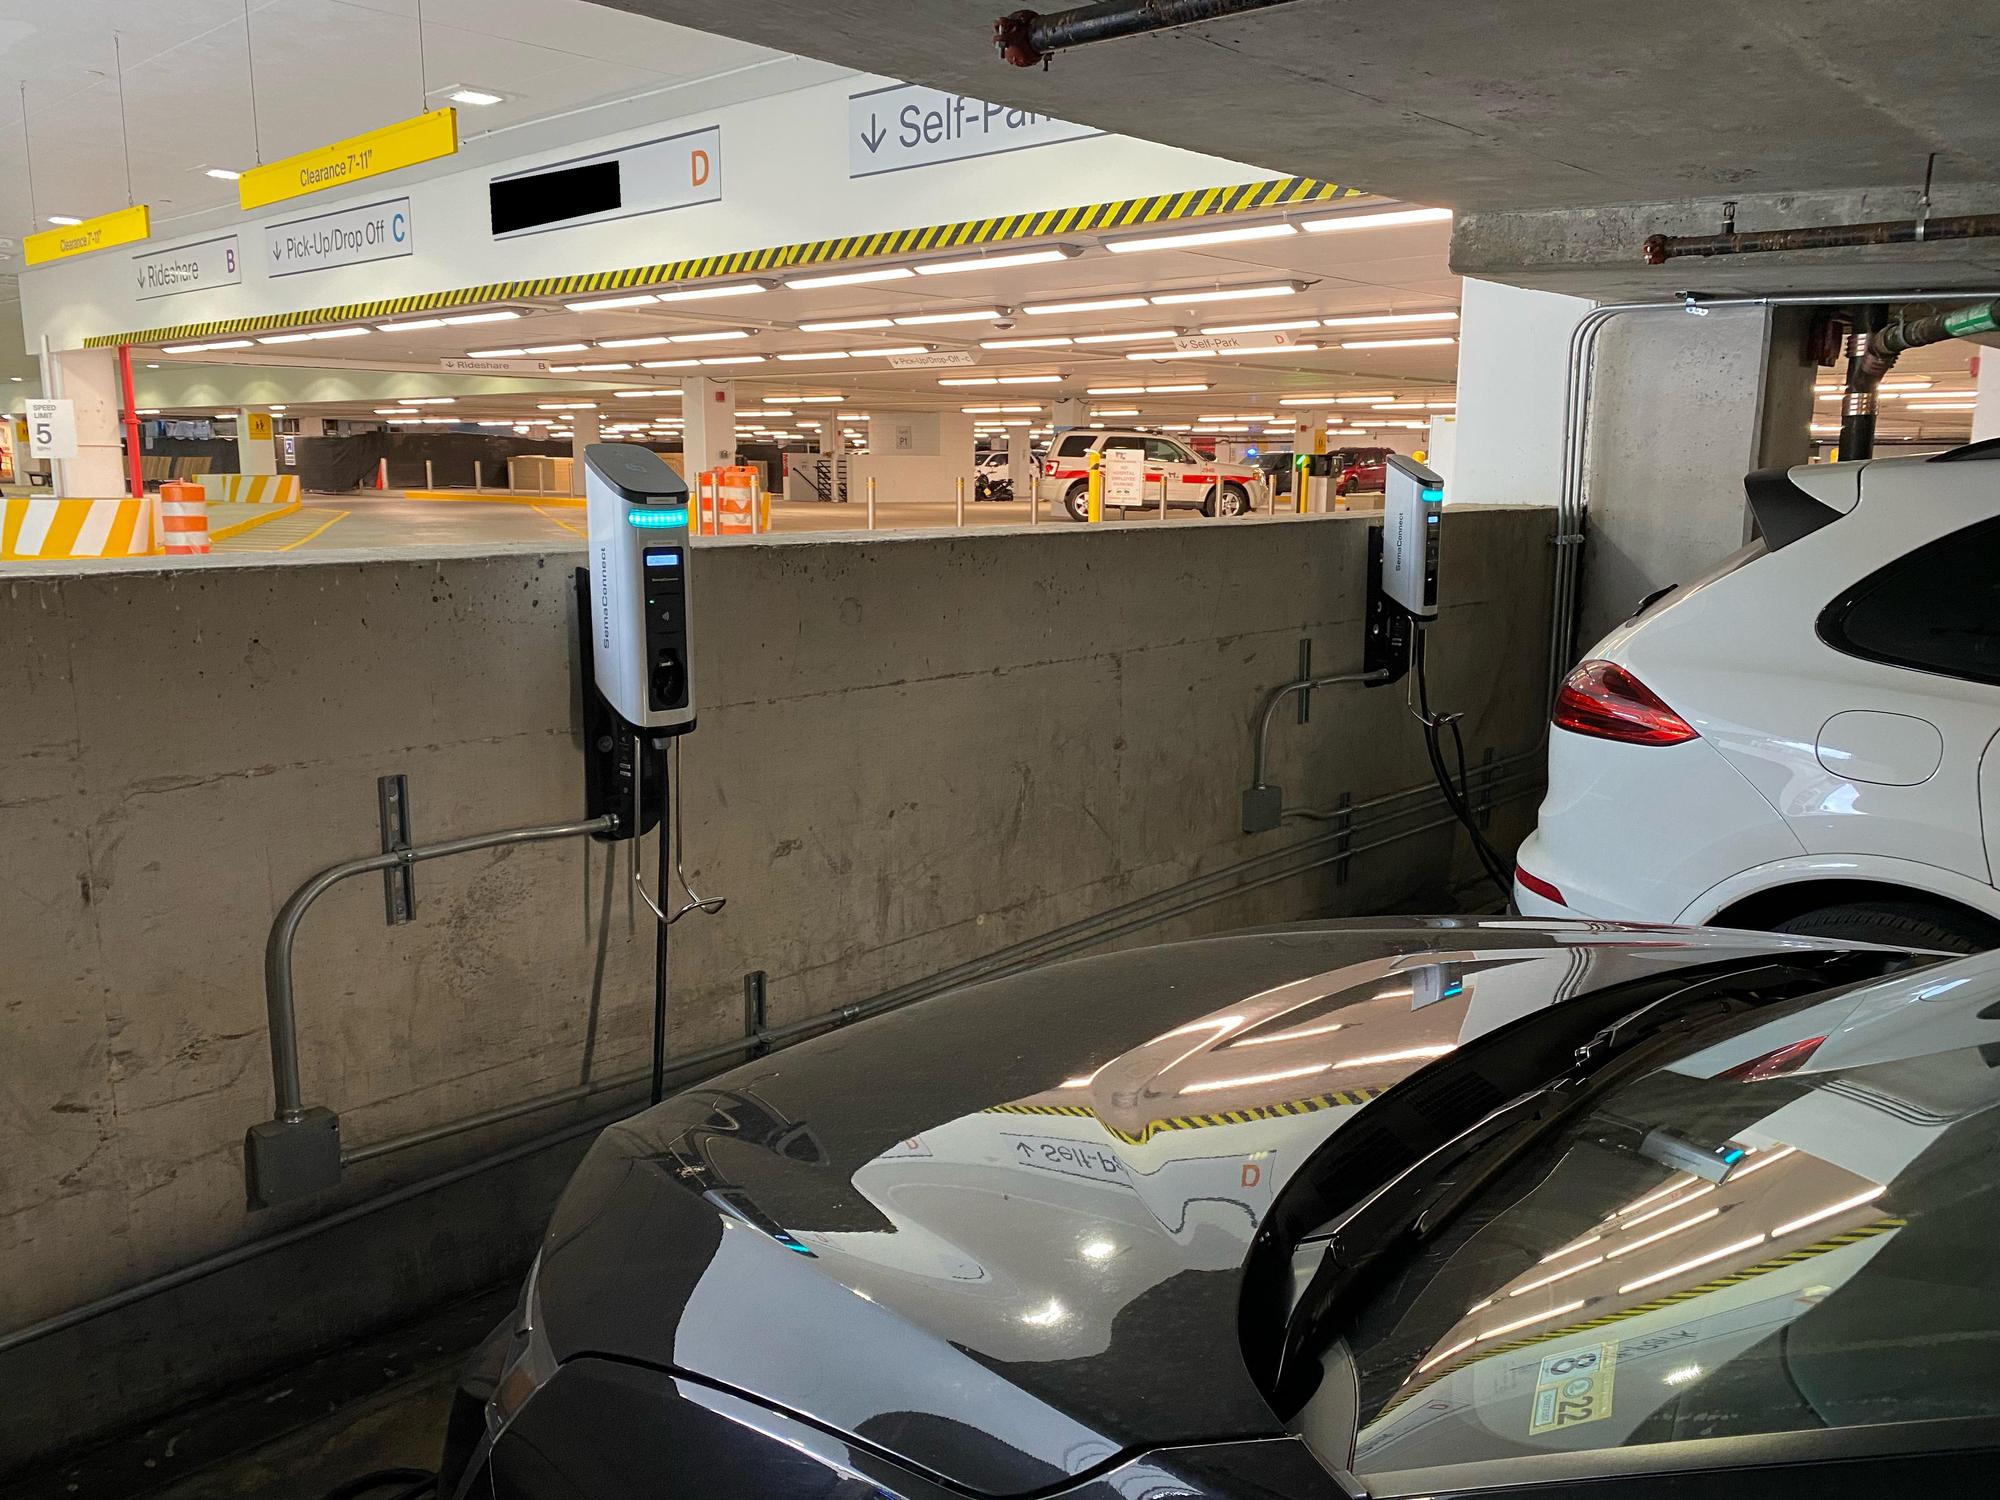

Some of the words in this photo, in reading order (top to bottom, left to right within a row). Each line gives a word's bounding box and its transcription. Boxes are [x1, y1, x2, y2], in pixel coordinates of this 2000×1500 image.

[300, 161, 346, 187] Clearance
[691, 149, 709, 187] D
[60, 235, 88, 252] Clearance
[286, 229, 363, 260] Pick-Up/Drop
[366, 219, 385, 244] Off
[392, 213, 405, 243] C
[147, 260, 199, 288] Rideshare
[226, 249, 235, 274] B
[1189, 337, 1240, 349] Self-Park
[1274, 334, 1285, 345] D
[457, 361, 510, 370] Rideshare
[538, 362, 546, 370] B
[36, 423, 52, 445] 5
[1395, 512, 1404, 572] SemaConnect
[601, 547, 610, 650] SemaConnect
[1550, 1352, 1597, 1376] 8
[1557, 1395, 1594, 1426] 22
